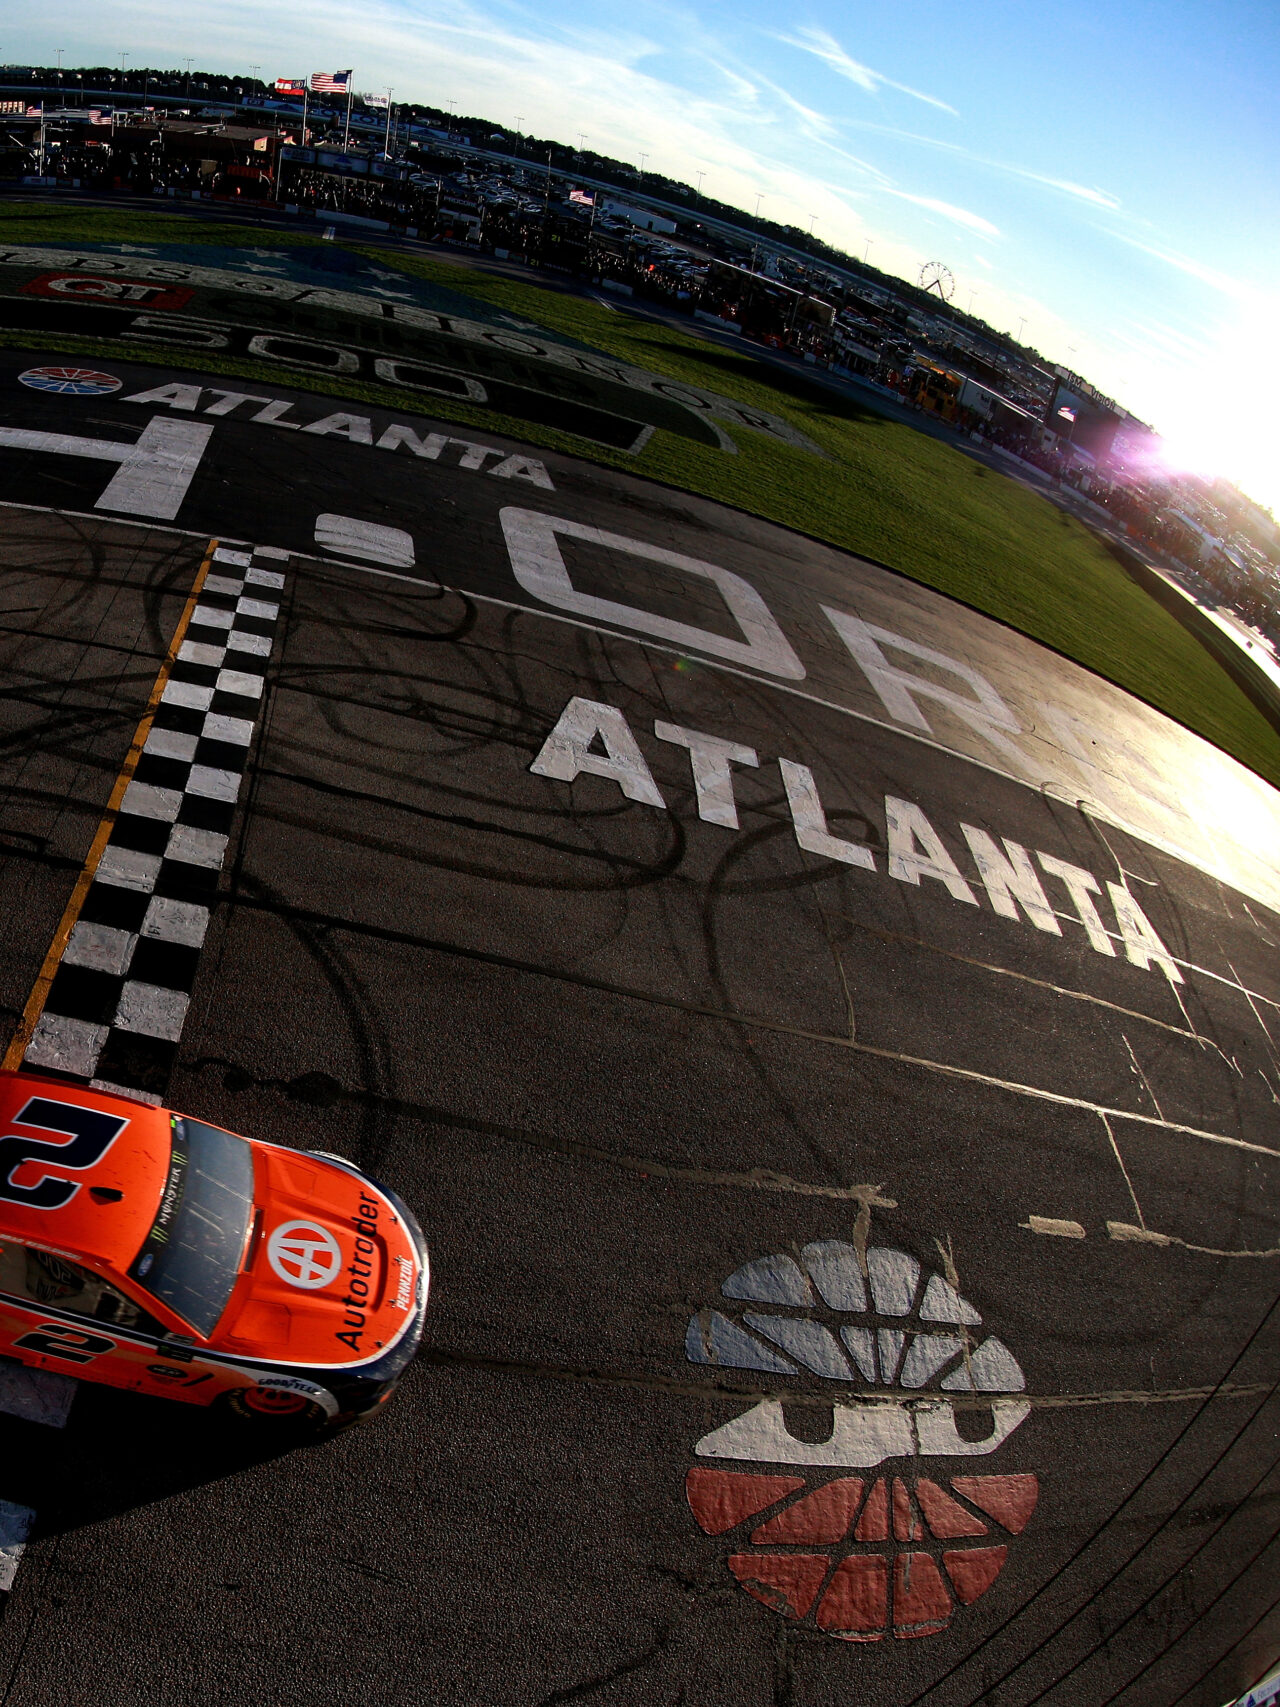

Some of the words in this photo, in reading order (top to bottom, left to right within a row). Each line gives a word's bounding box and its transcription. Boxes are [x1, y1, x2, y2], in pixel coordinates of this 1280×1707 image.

[47, 276, 173, 304] QT
[120, 314, 488, 405] 500
[378, 302, 786, 436] HONOR
[1067, 372, 1082, 389] ISM
[1089, 387, 1116, 411] VISION
[118, 382, 558, 492] ATLANTA
[529, 694, 1187, 986] ATLANTA
[158, 1167, 182, 1226] MONSTER
[335, 1190, 382, 1352] Autotrader
[395, 1257, 414, 1312] PENNZOIL
[11, 1322, 119, 1366] 2
